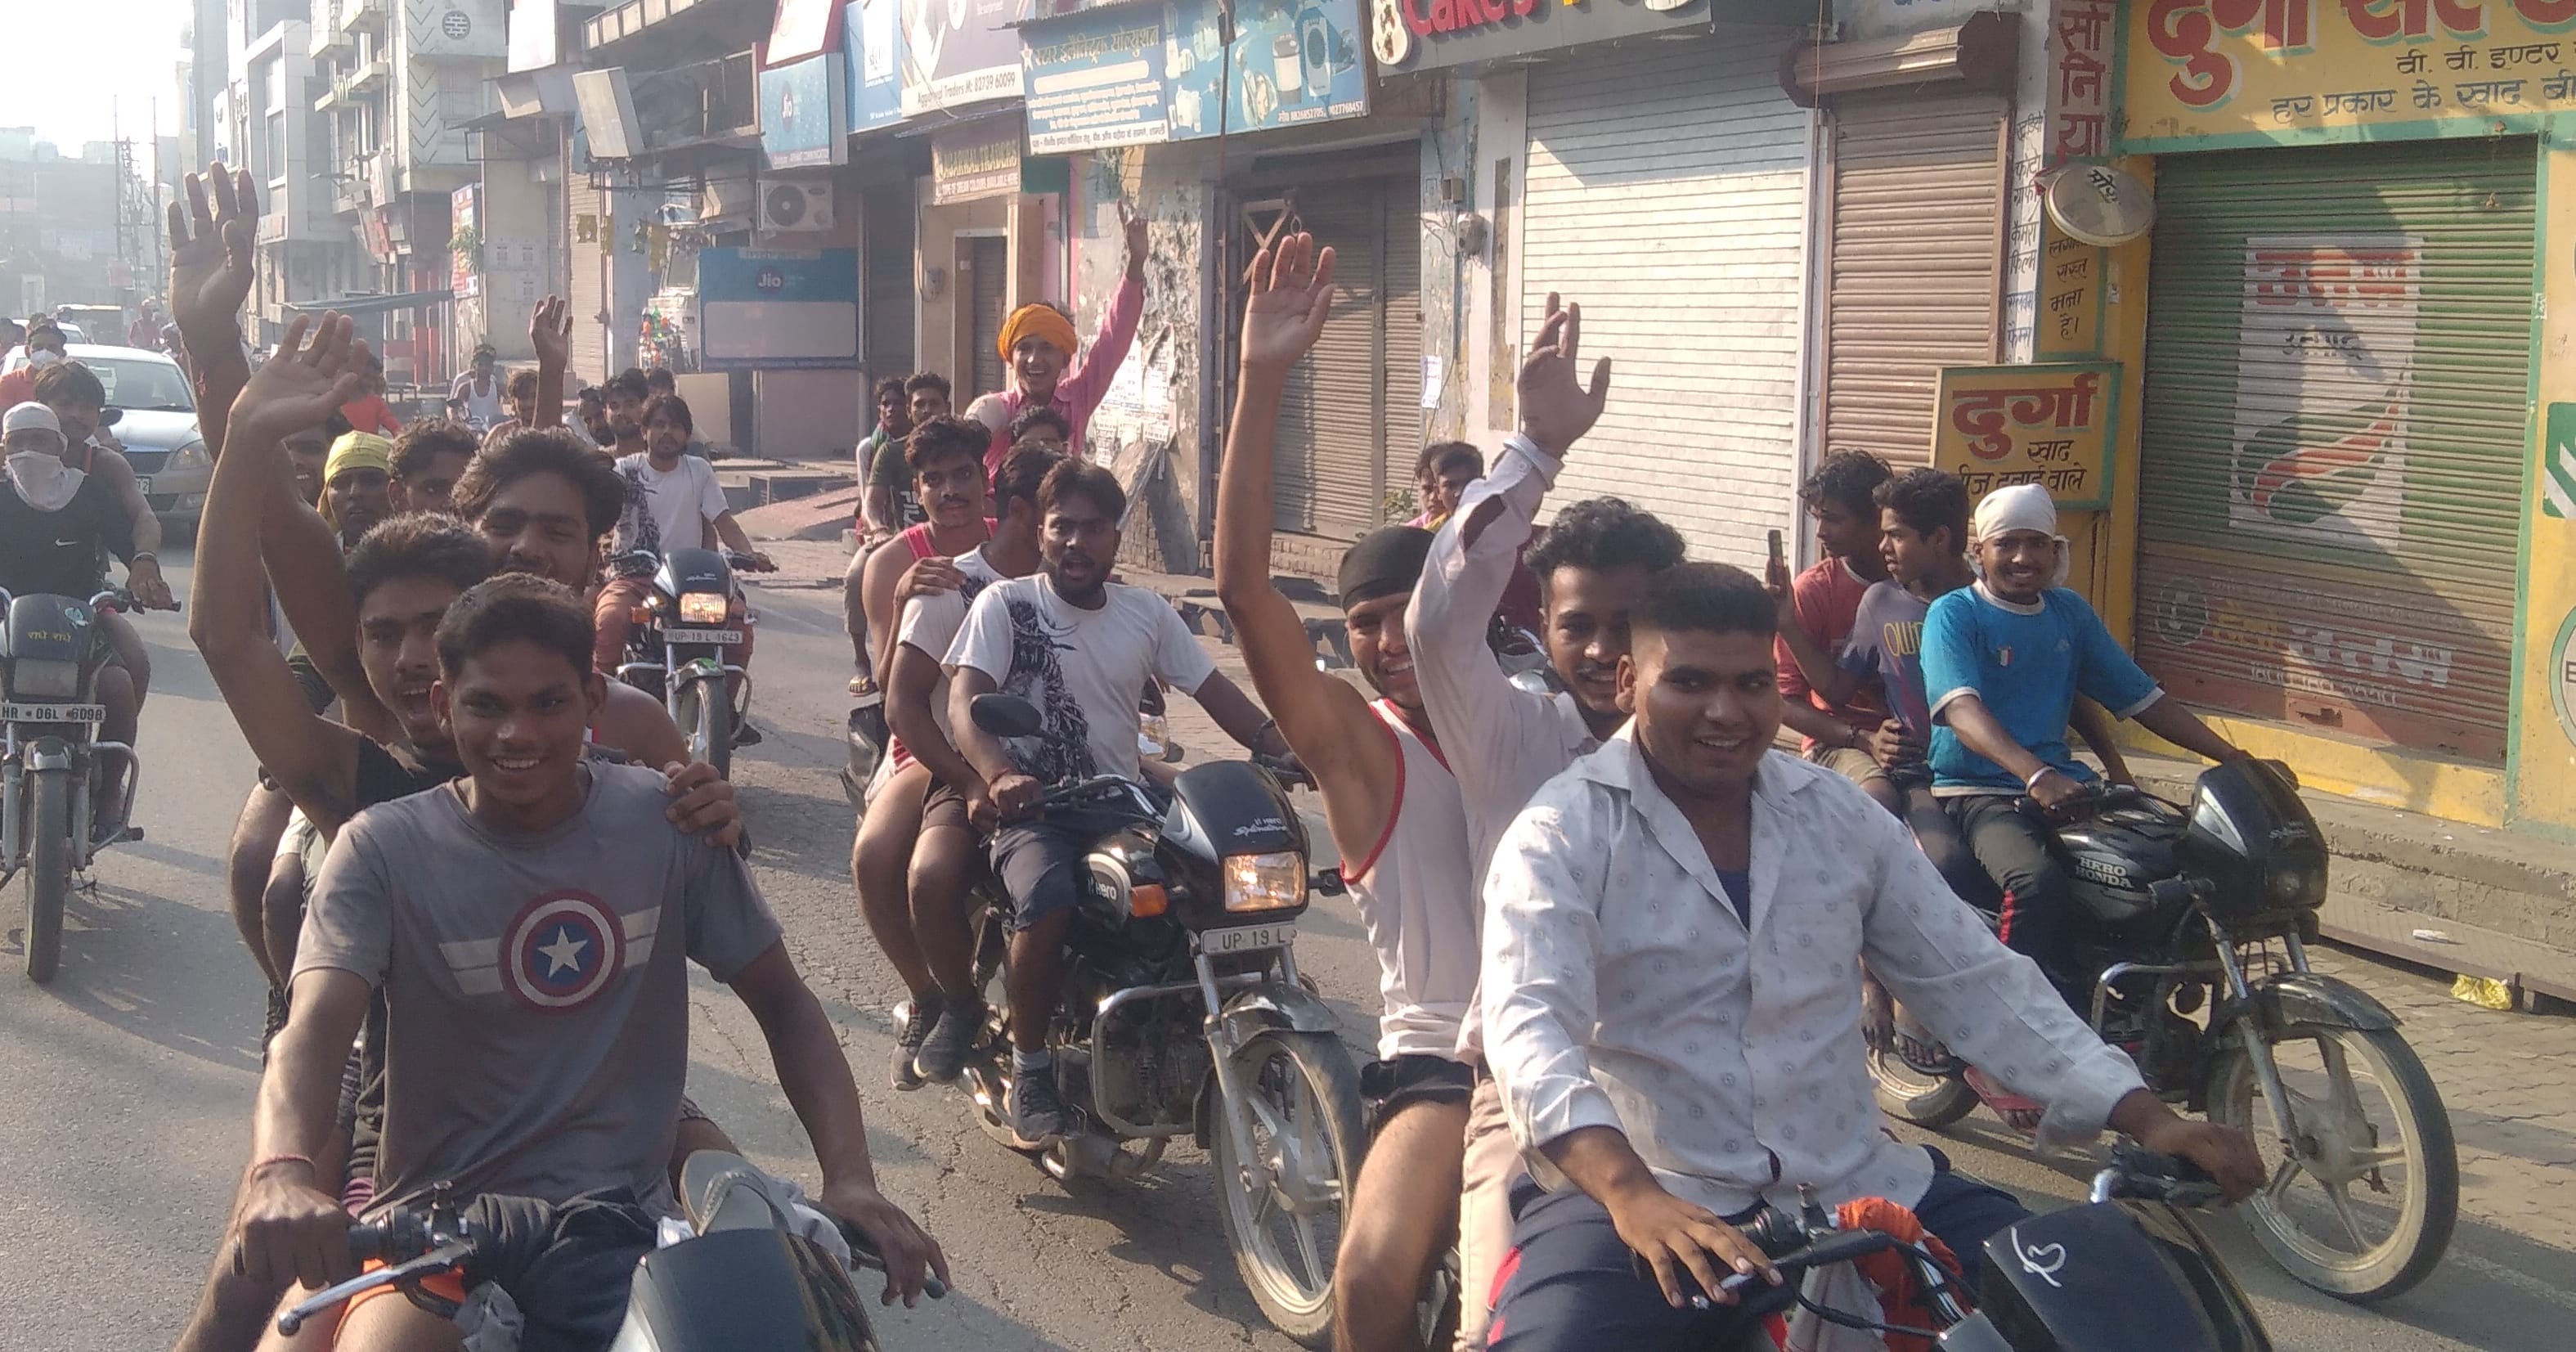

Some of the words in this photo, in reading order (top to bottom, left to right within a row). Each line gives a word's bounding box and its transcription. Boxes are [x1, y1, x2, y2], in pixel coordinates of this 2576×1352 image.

[2270, 96, 2314, 124] हर
[2322, 88, 2398, 117] प्रकार
[2412, 79, 2442, 109] के
[2455, 79, 2528, 109] खाद
[2540, 69, 2576, 101] बी
[758, 272, 783, 288] Jio
[1951, 371, 2100, 460] दुर्गा
[2026, 439, 2075, 464] खाद
[1958, 463, 1995, 496] ीज
[2047, 461, 2088, 493] वाले
[674, 632, 686, 642] UP
[705, 632, 711, 642] L
[2, 707, 19, 719] HR
[2075, 865, 2134, 889] HONDA
[2080, 856, 2126, 878] HERO
[1222, 932, 1243, 950] UP
[1252, 930, 1270, 947] 19
[1277, 928, 1286, 945] L
